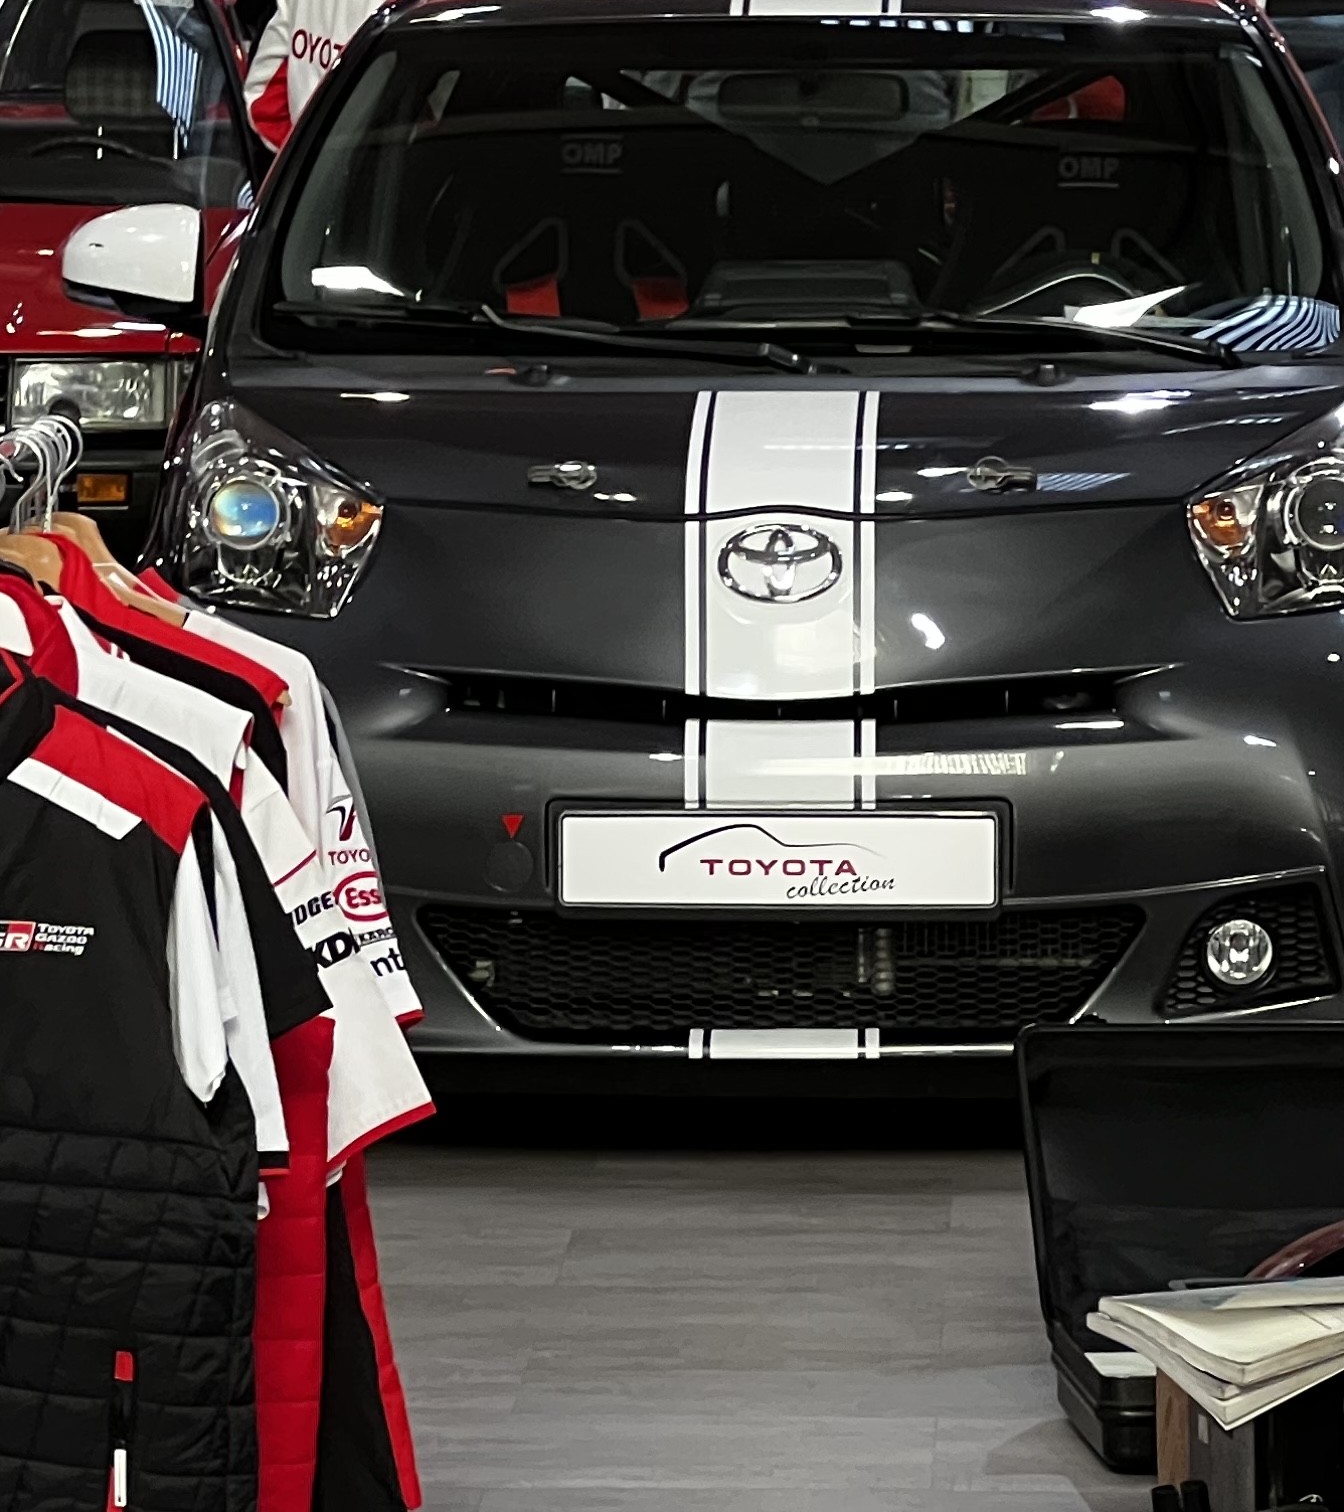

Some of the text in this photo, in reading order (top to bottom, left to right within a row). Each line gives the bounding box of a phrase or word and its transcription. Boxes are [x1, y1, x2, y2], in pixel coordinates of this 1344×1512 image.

[291, 29, 345, 69] OYO
[561, 142, 623, 165] OMP
[1058, 156, 1119, 179] OMP
[327, 848, 372, 866] TOYO
[699, 859, 858, 876] TOYOTA
[345, 887, 383, 910] Ess
[786, 875, 896, 900] collection
[294, 890, 335, 926] DGE
[34, 933, 88, 945] GAZOO
[37, 922, 95, 937] TOYOTA
